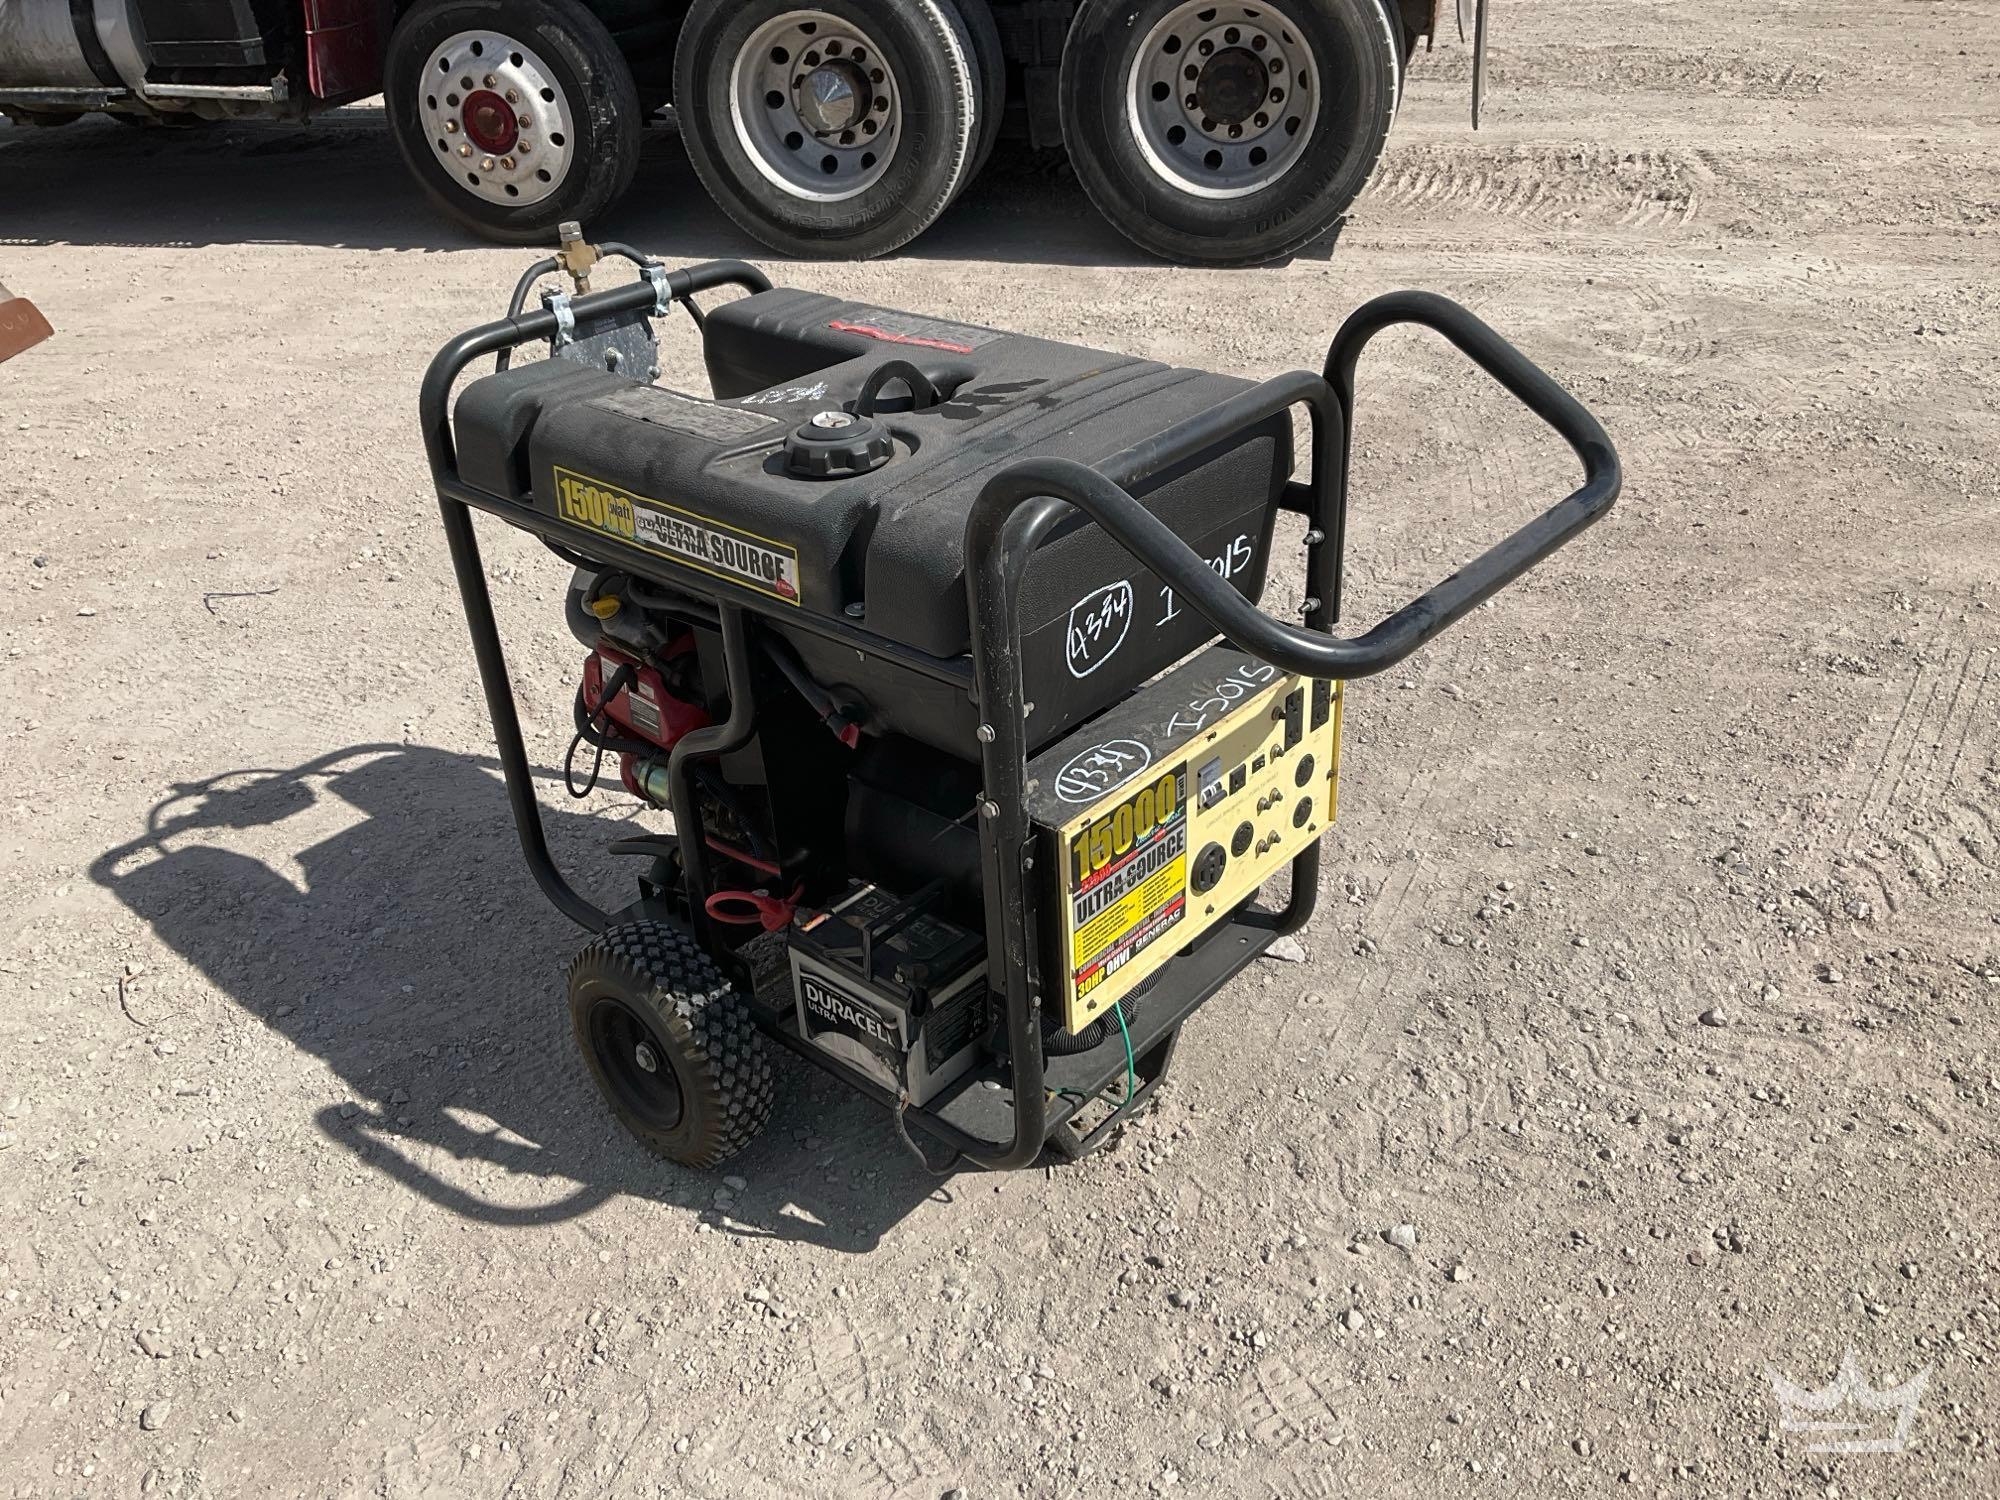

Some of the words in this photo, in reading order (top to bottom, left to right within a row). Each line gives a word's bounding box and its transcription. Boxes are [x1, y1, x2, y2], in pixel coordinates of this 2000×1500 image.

[559, 477, 635, 538] 15000
[636, 516, 699, 545] GUARDIAN
[653, 514, 709, 559] ULTRA
[711, 534, 785, 582] SOURCE
[1073, 774, 1176, 881] 15000
[1076, 873, 1124, 924] ULTRA
[1126, 828, 1185, 887] SOURCE
[1078, 966, 1106, 998] 30HP
[1135, 908, 1181, 947] GENERAC
[807, 1000, 839, 1025] ULTRA
